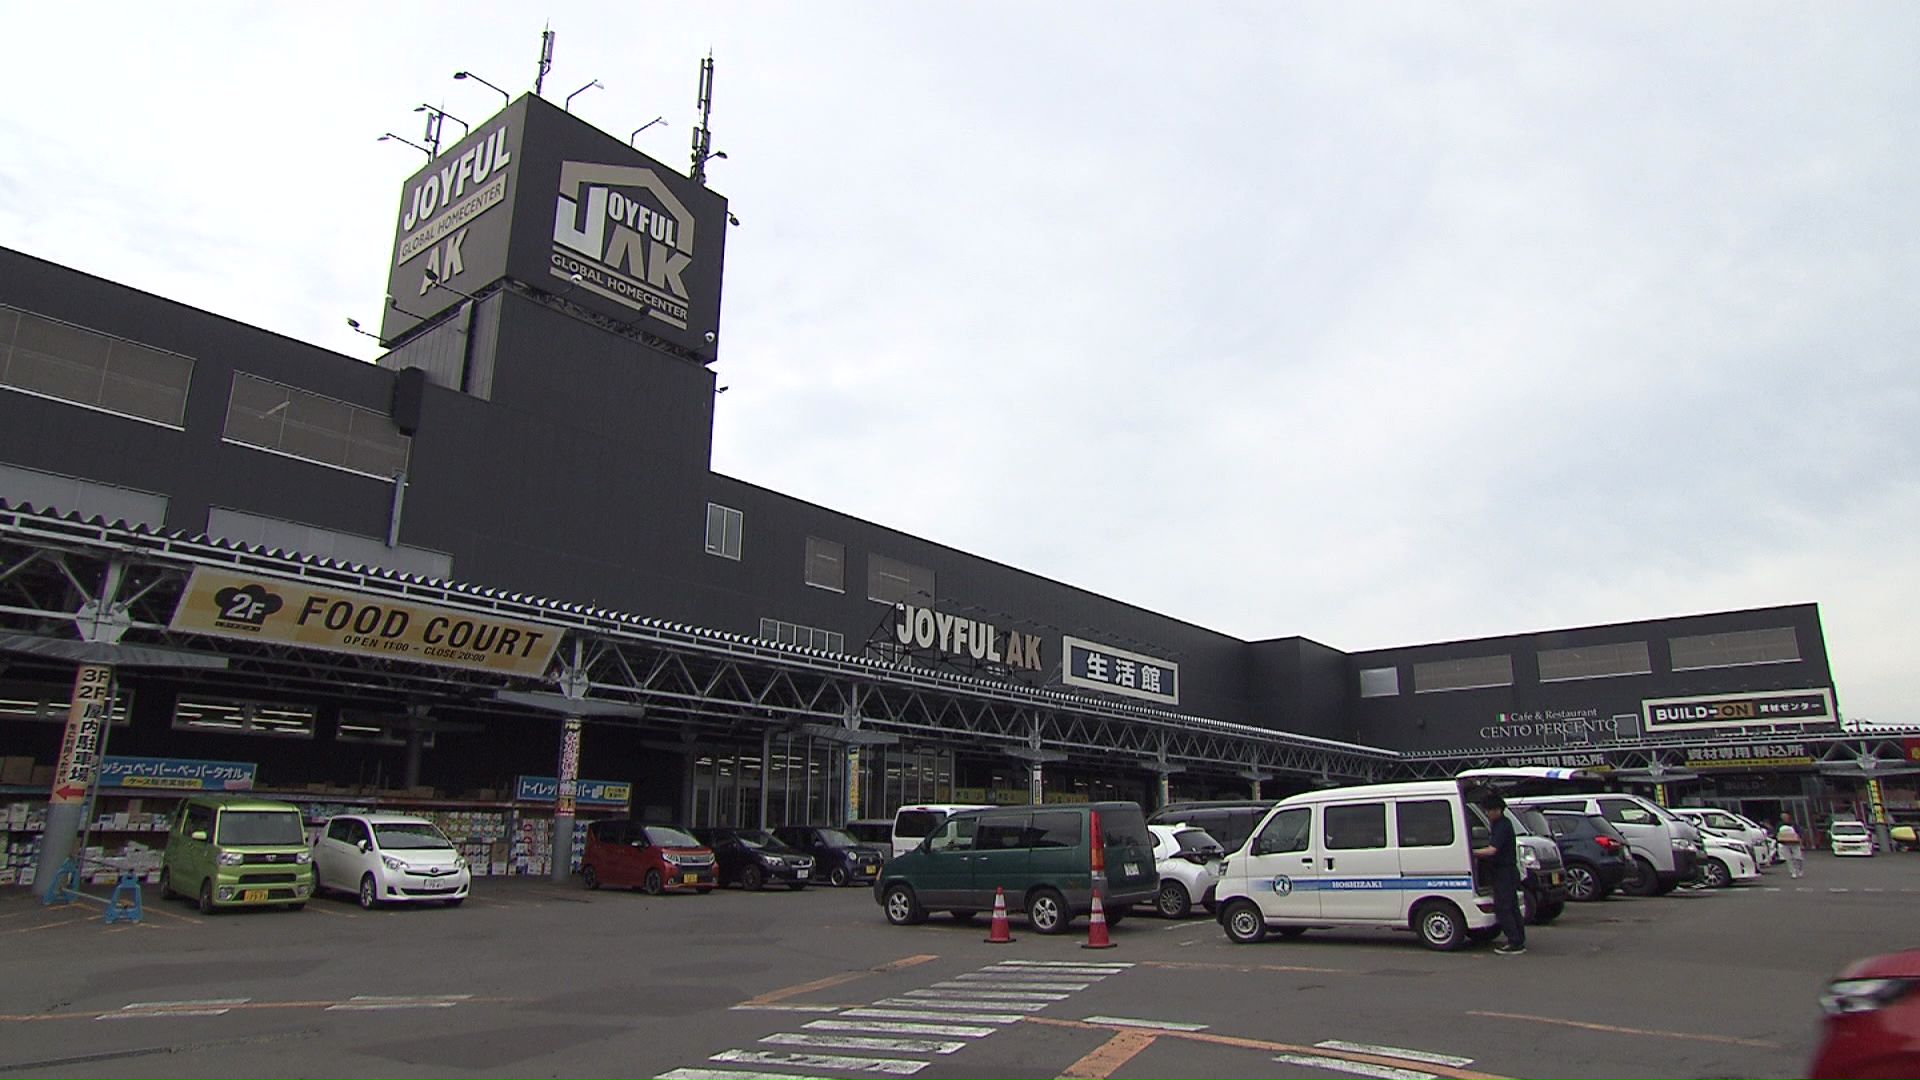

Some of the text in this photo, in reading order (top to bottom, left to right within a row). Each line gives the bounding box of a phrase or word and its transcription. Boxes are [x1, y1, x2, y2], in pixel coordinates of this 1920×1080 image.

[404, 126, 511, 232] JOYFUL
[402, 183, 501, 257] GLOBAL HOMECENTER
[553, 187, 677, 262] JOYFUL
[420, 228, 468, 296] AK
[552, 254, 688, 320] GLOBAL HOMECENTER
[604, 224, 692, 300] AK
[226, 593, 265, 619] 2F
[297, 596, 543, 659] FOOD COURT
[344, 635, 378, 648] OPEN
[383, 641, 409, 651] 11:00
[424, 647, 456, 659] CLOSE
[457, 651, 486, 662] 20:00
[896, 604, 1042, 672] JOYFUL AK
[79, 686, 106, 699] 2F
[83, 669, 109, 682] 3F
[1086, 653, 1161, 694] 生活館
[1480, 719, 1618, 738] CENTO PERCENTO
[1511, 708, 1597, 722] Cafe & Restaurant
[1331, 881, 1382, 889] HOSHIZAKI
